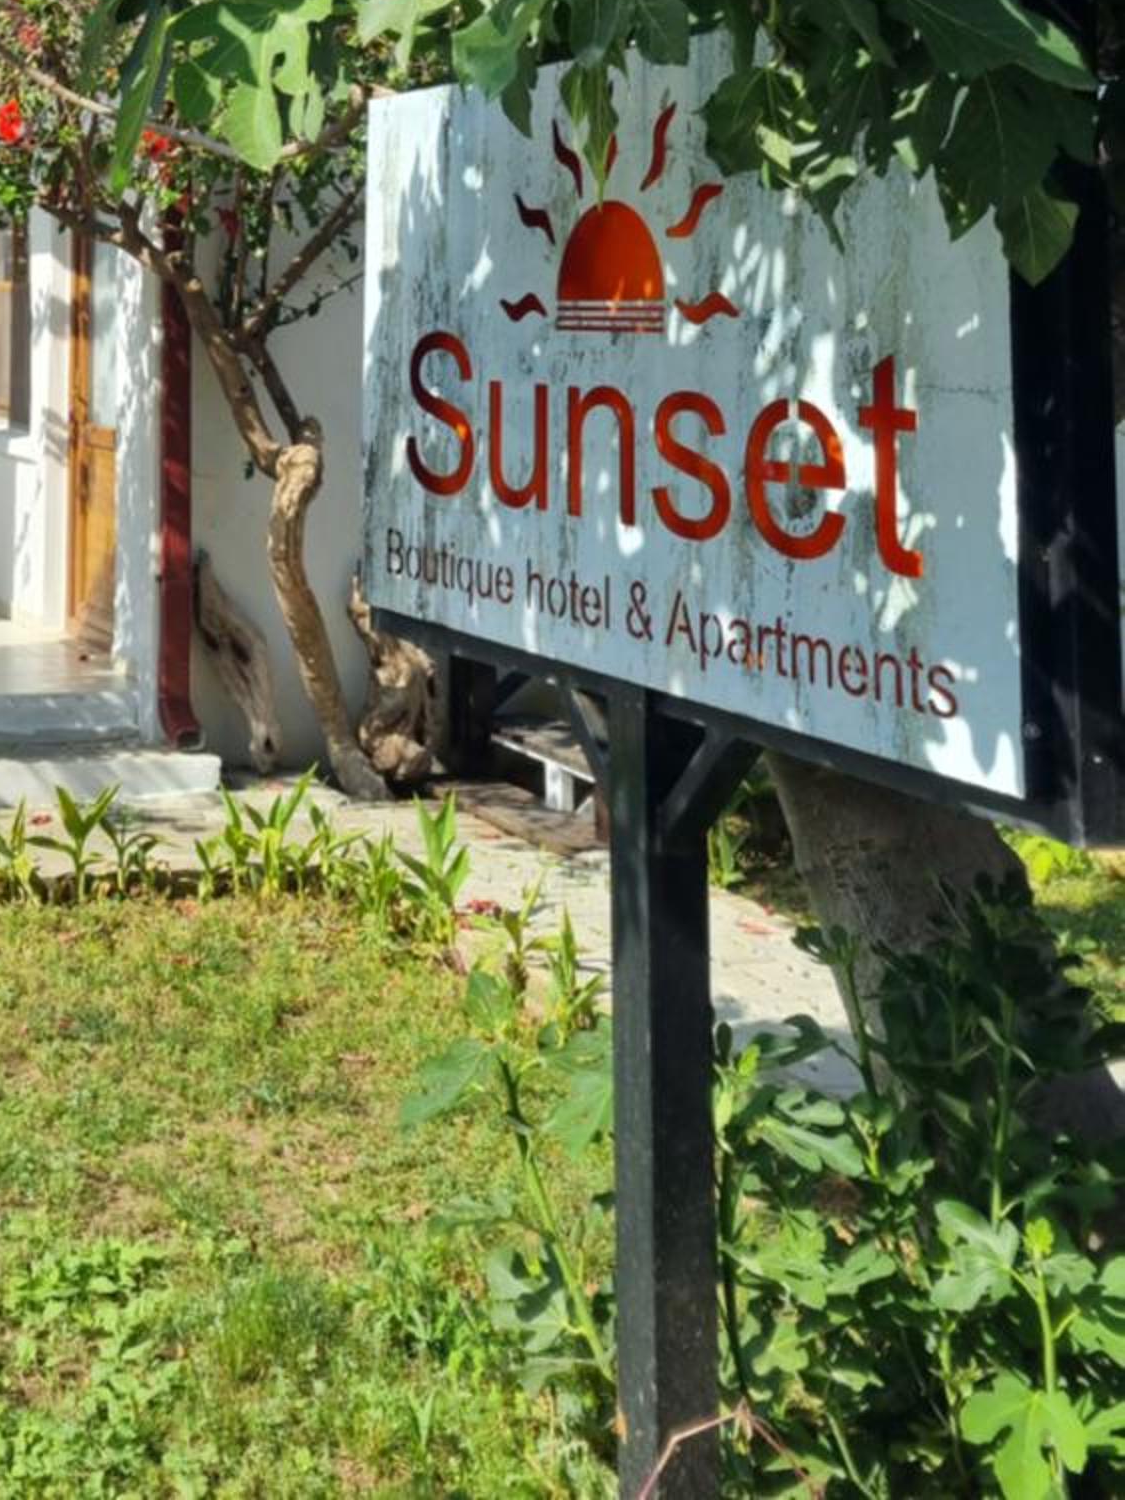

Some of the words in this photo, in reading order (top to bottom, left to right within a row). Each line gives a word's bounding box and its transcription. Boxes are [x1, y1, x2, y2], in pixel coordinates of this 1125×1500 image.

[406, 330, 924, 579] Sunset
[386, 528, 514, 607] Boutique
[526, 557, 611, 629] hotel
[626, 580, 654, 642] &
[665, 589, 958, 718] Apartments
